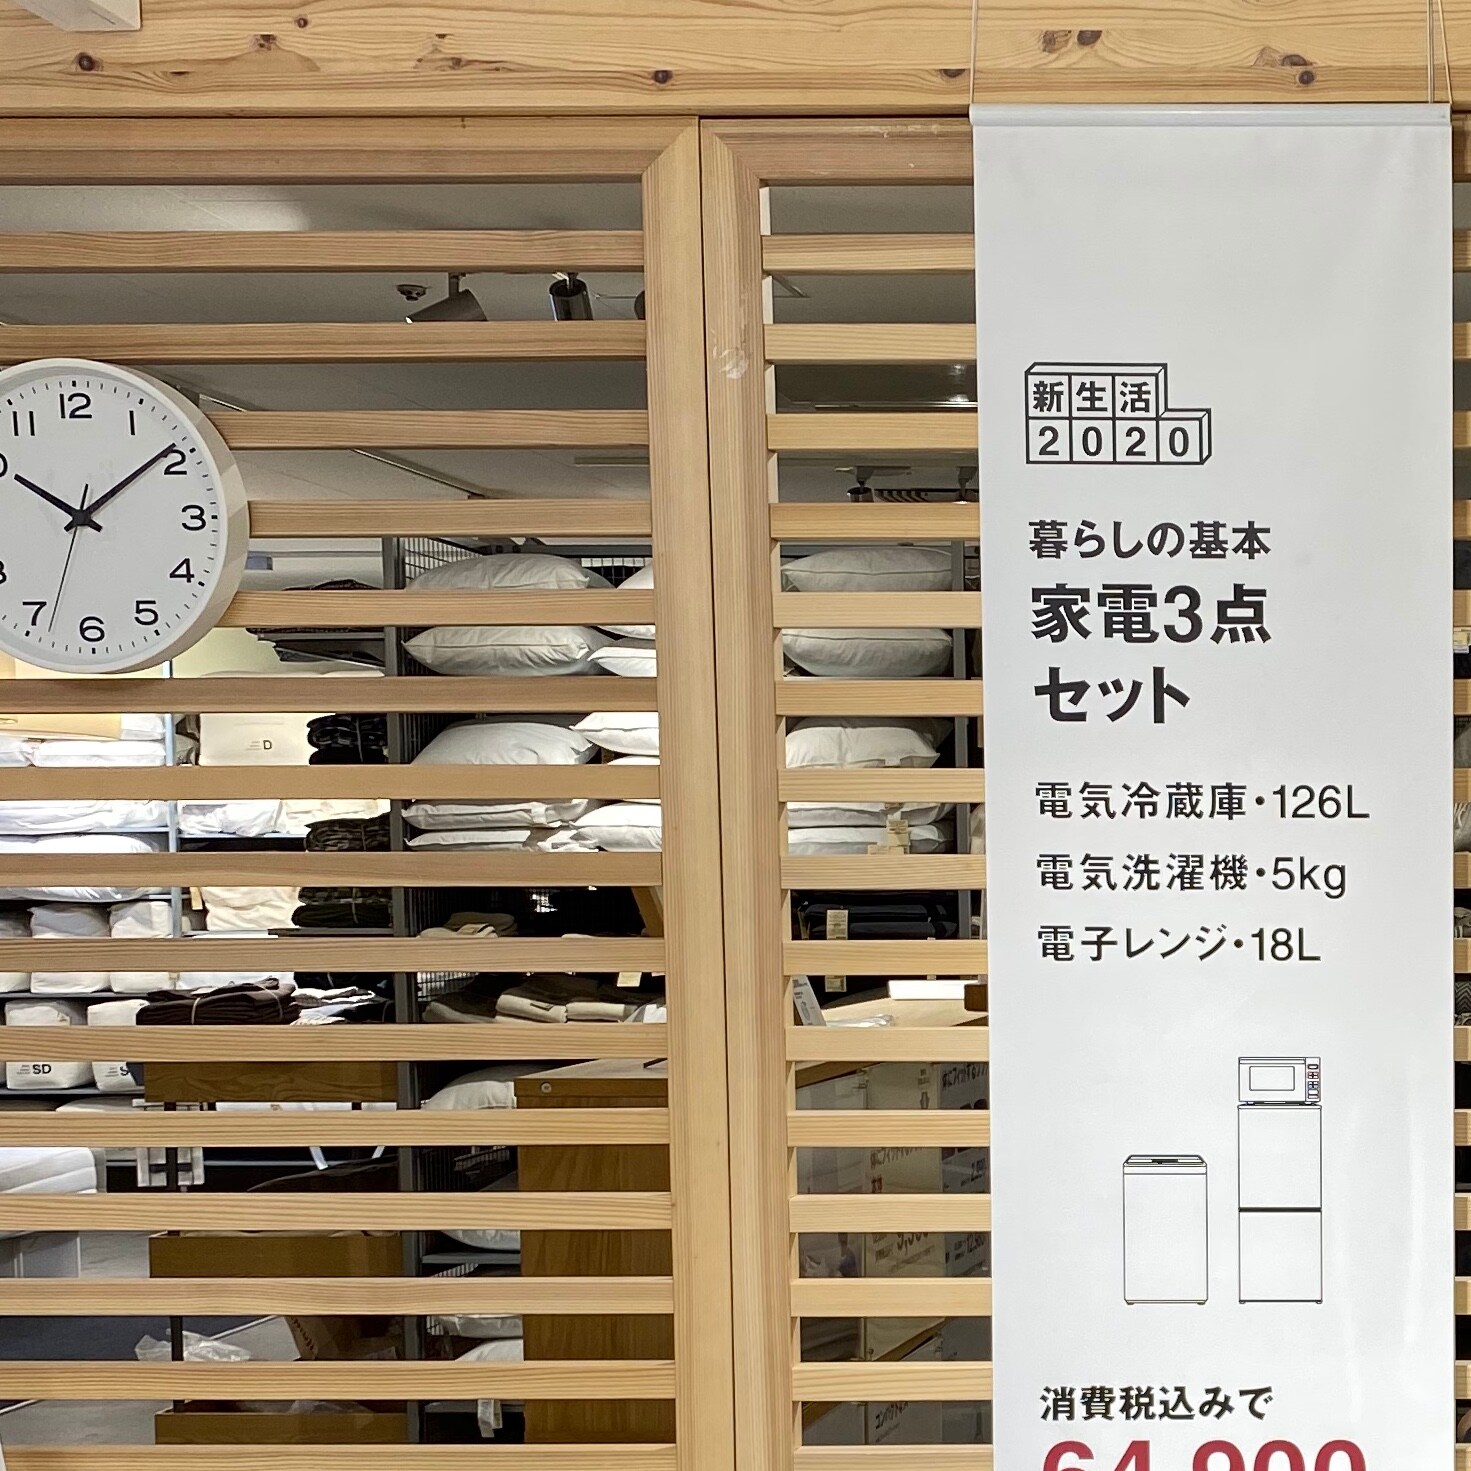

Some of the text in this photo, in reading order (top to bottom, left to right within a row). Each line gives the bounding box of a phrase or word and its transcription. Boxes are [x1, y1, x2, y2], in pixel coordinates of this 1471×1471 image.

[59, 393, 93, 420] 12
[1033, 380, 1151, 413] 新生活
[12, 410, 36, 437] 11
[128, 410, 136, 436] 1
[1038, 425, 1190, 457] 2020
[164, 448, 188, 476] 2
[181, 504, 207, 532] 3
[1029, 519, 1272, 560] 暮らしの基本
[169, 557, 195, 584] 4
[22, 600, 48, 627] 7
[134, 599, 159, 626] 5
[1031, 582, 1272, 645] 家電3点
[79, 615, 106, 643] 6
[1033, 666, 1191, 724] セット
[1036, 781, 1370, 821] 電気冷蔵庫・126L
[1037, 852, 1346, 900] 電気洗濯機・5kg
[1038, 923, 1321, 962] 電子レンジ・18L
[32, 1063, 52, 1076] SD
[1039, 1385, 1274, 1421] 消費税込みで
